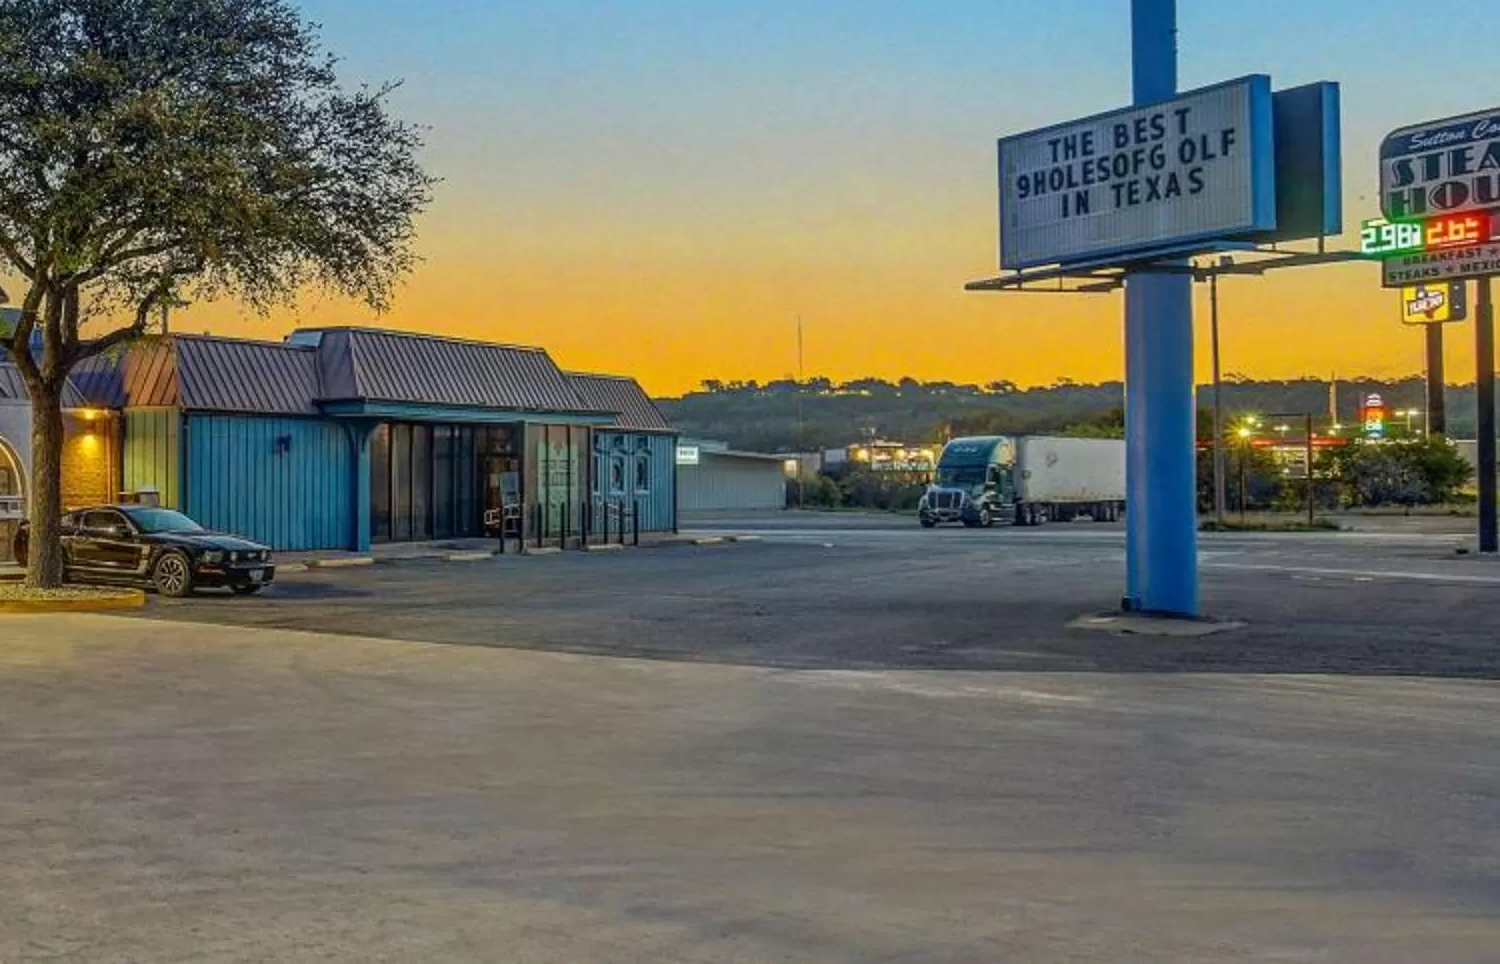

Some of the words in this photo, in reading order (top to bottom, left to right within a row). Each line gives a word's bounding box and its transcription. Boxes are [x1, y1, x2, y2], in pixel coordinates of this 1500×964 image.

[1048, 130, 1094, 163] THE
[1114, 107, 1192, 149] BEST
[1061, 189, 1090, 218] IN
[1111, 167, 1205, 208] TEXAS
[1388, 267, 1440, 282] STEAKS
